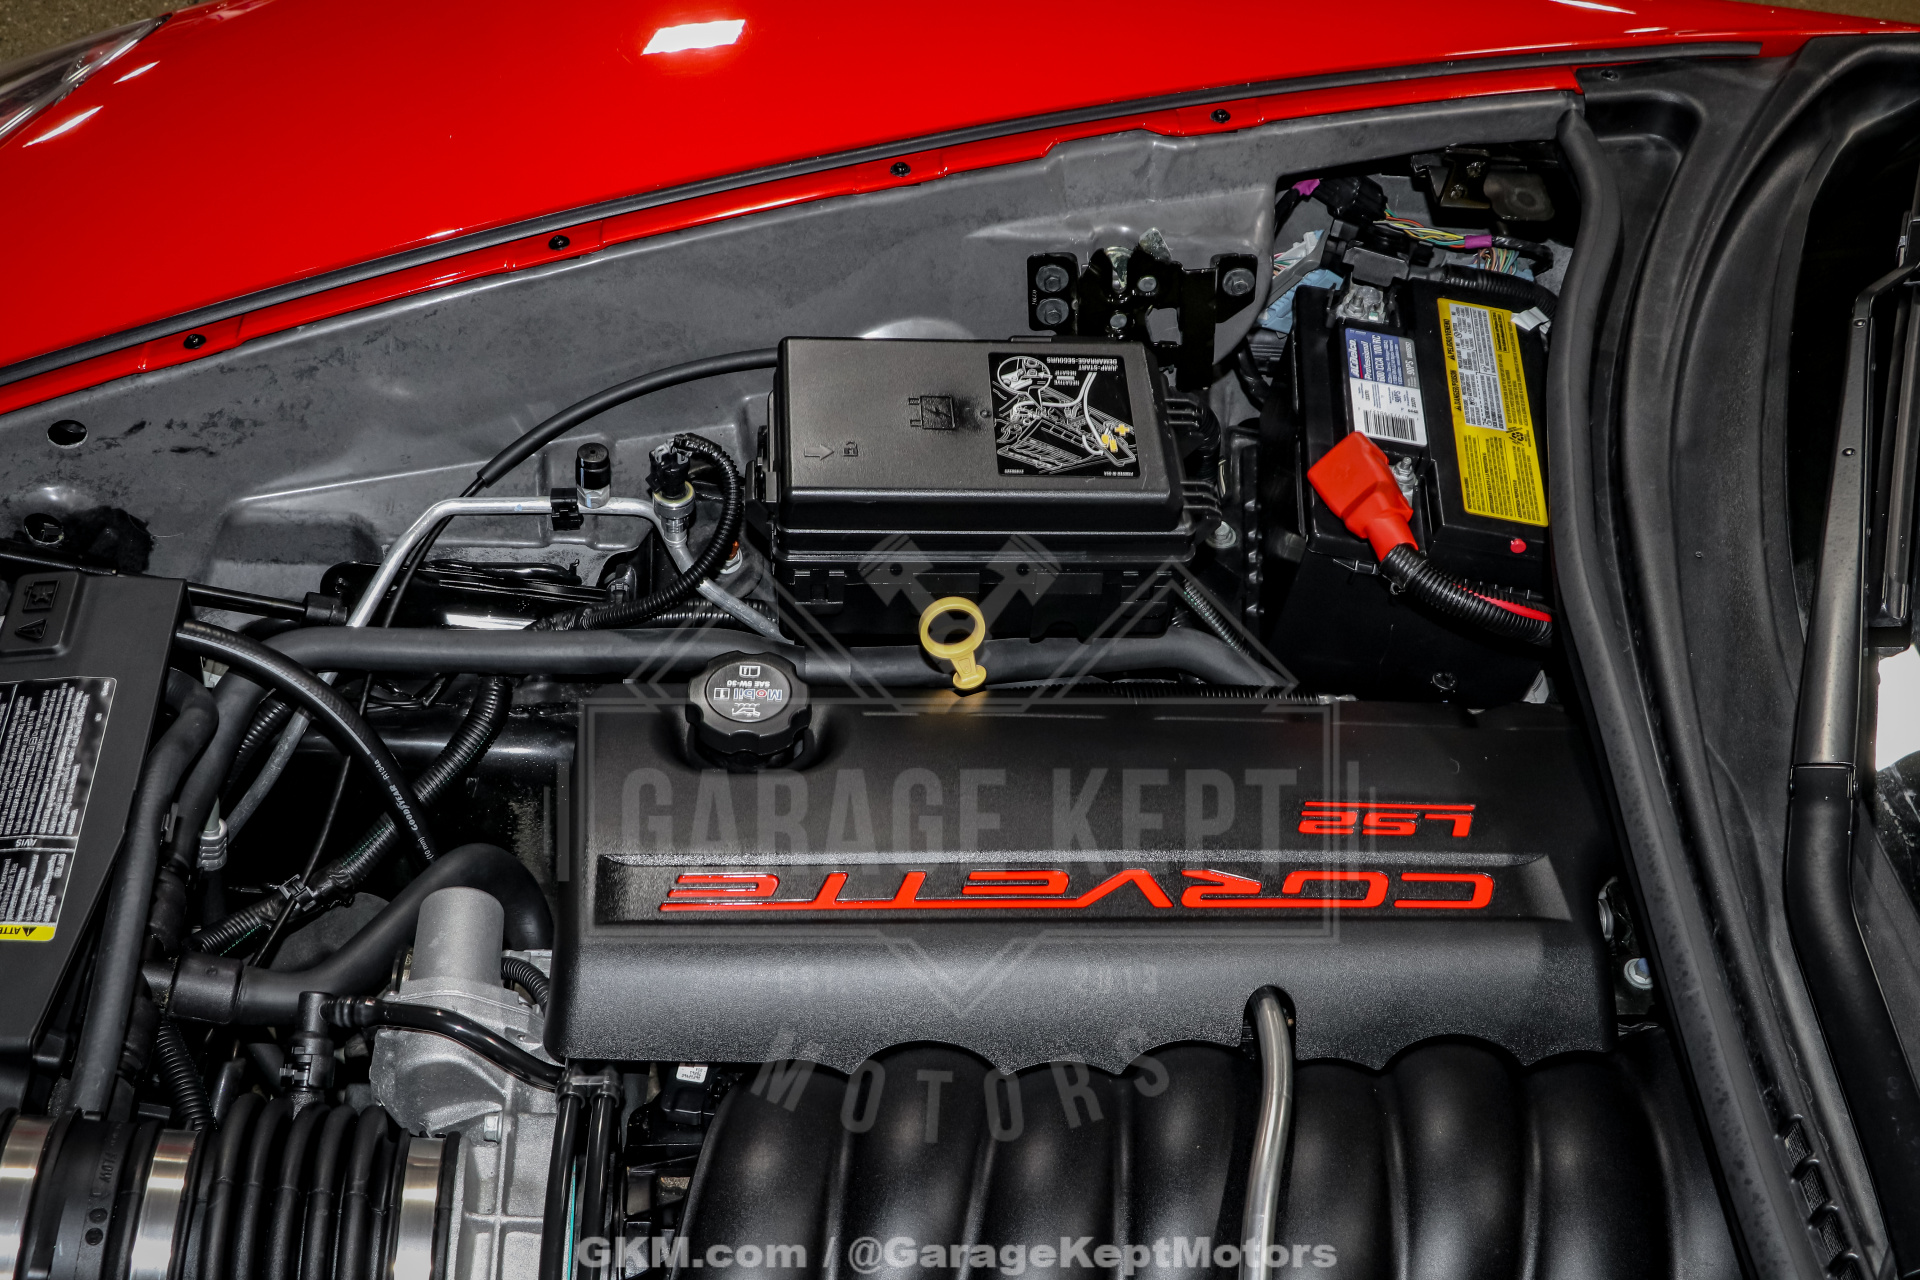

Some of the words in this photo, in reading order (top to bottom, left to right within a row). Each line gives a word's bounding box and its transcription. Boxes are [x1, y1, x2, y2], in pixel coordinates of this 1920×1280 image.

[1372, 334, 1381, 345] RC
[1361, 340, 1372, 380] Professional
[1375, 357, 1384, 370] CCA
[727, 680, 752, 688] 5W-30
[754, 680, 770, 688] SAE
[734, 688, 782, 702] Mobil
[389, 784, 418, 831] GOODYEAR
[1298, 801, 1476, 837] LS2
[15, 838, 37, 847] AVIS
[660, 869, 1494, 911] CORVETTE
